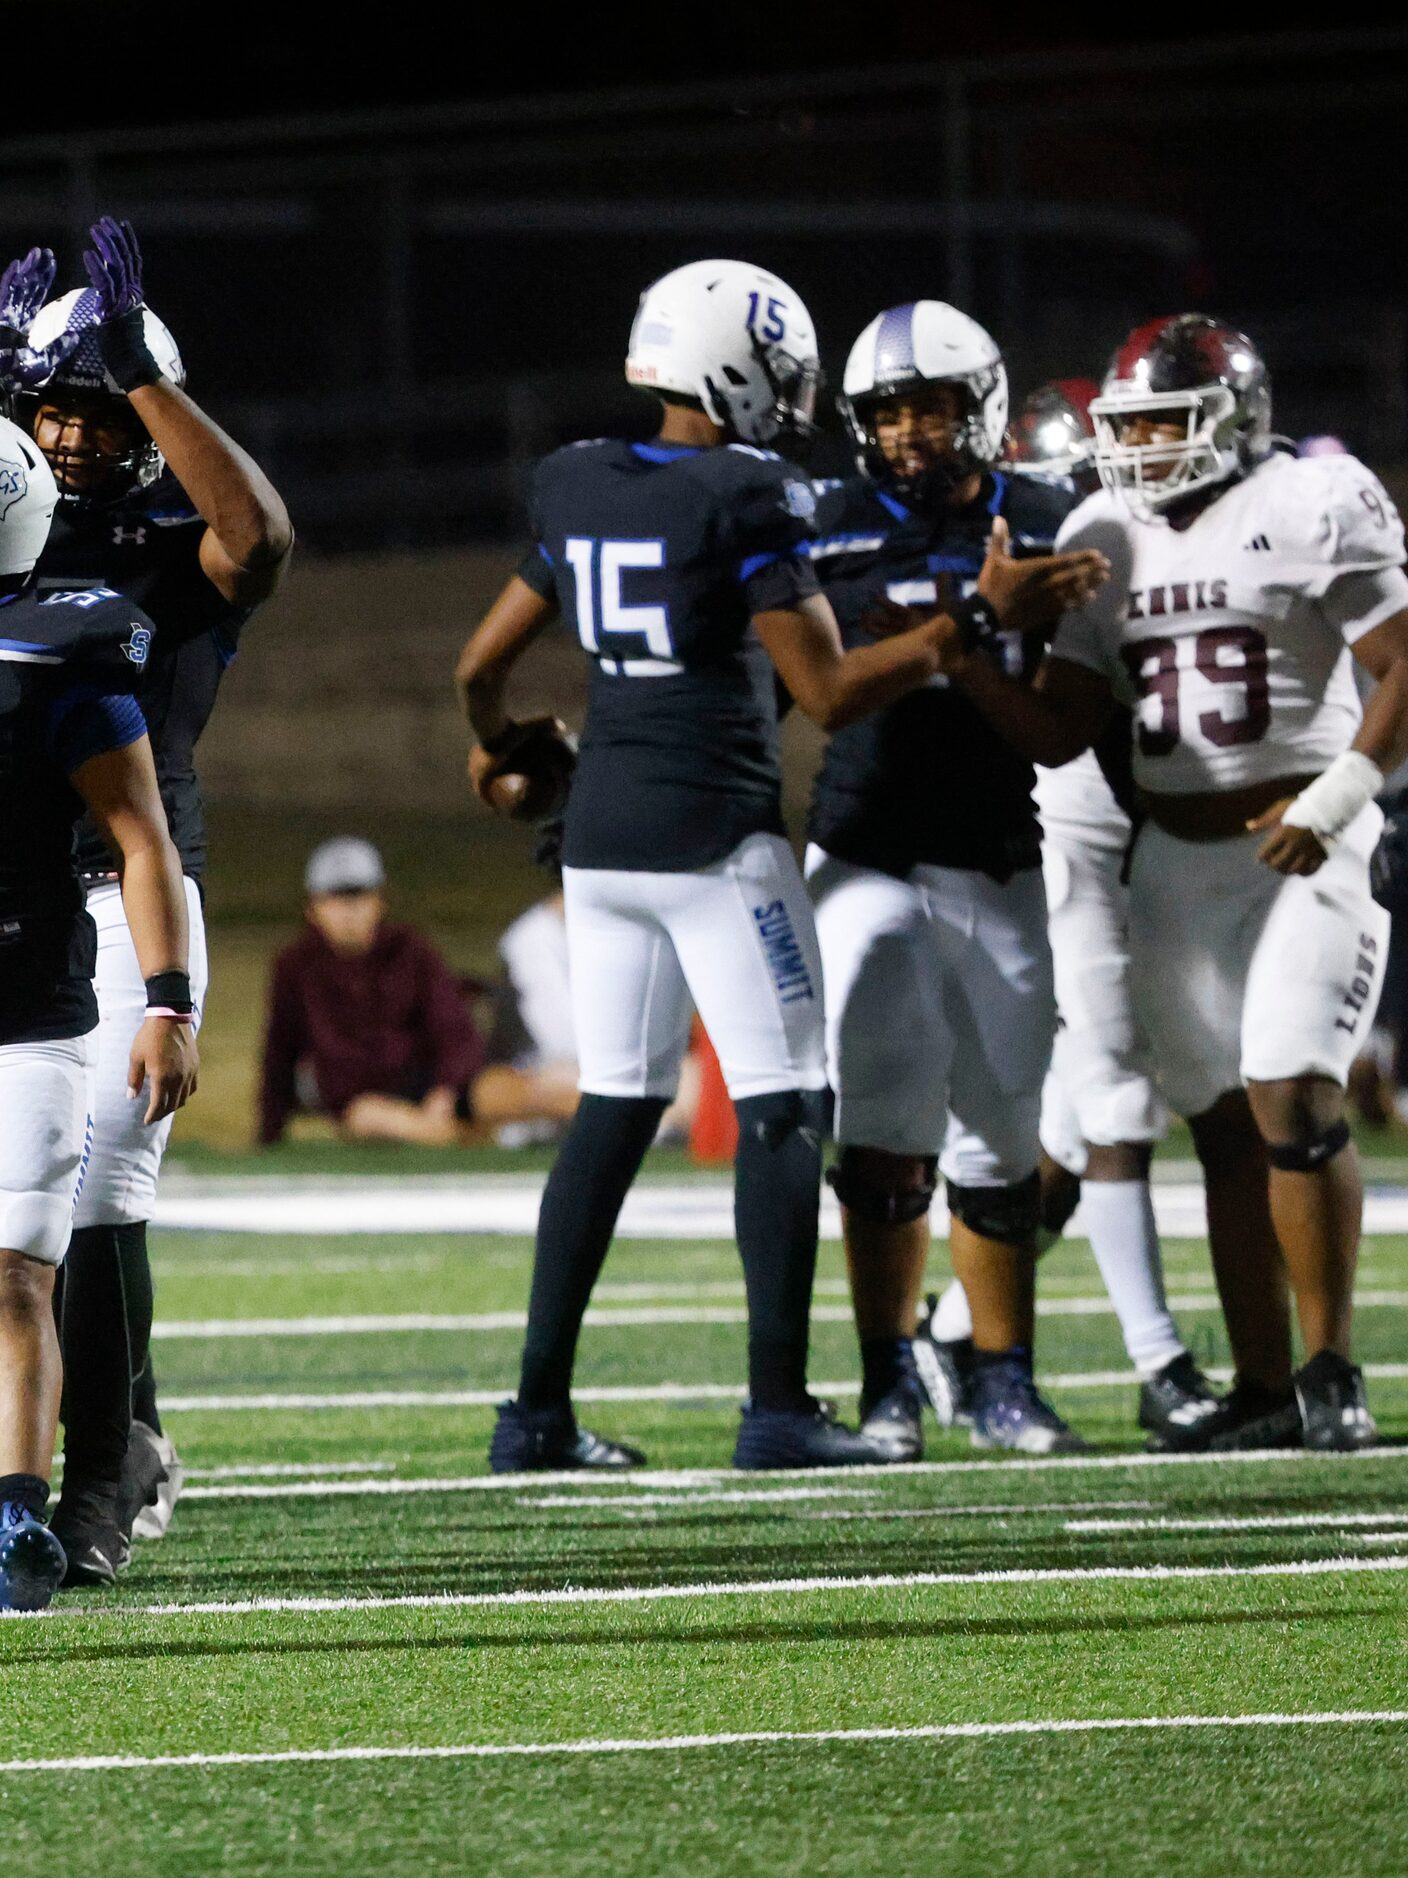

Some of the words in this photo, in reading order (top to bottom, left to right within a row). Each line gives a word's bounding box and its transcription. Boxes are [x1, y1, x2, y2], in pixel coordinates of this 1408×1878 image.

[746, 291, 789, 342] 15
[565, 536, 684, 677] 15
[1120, 626, 1271, 756] 99
